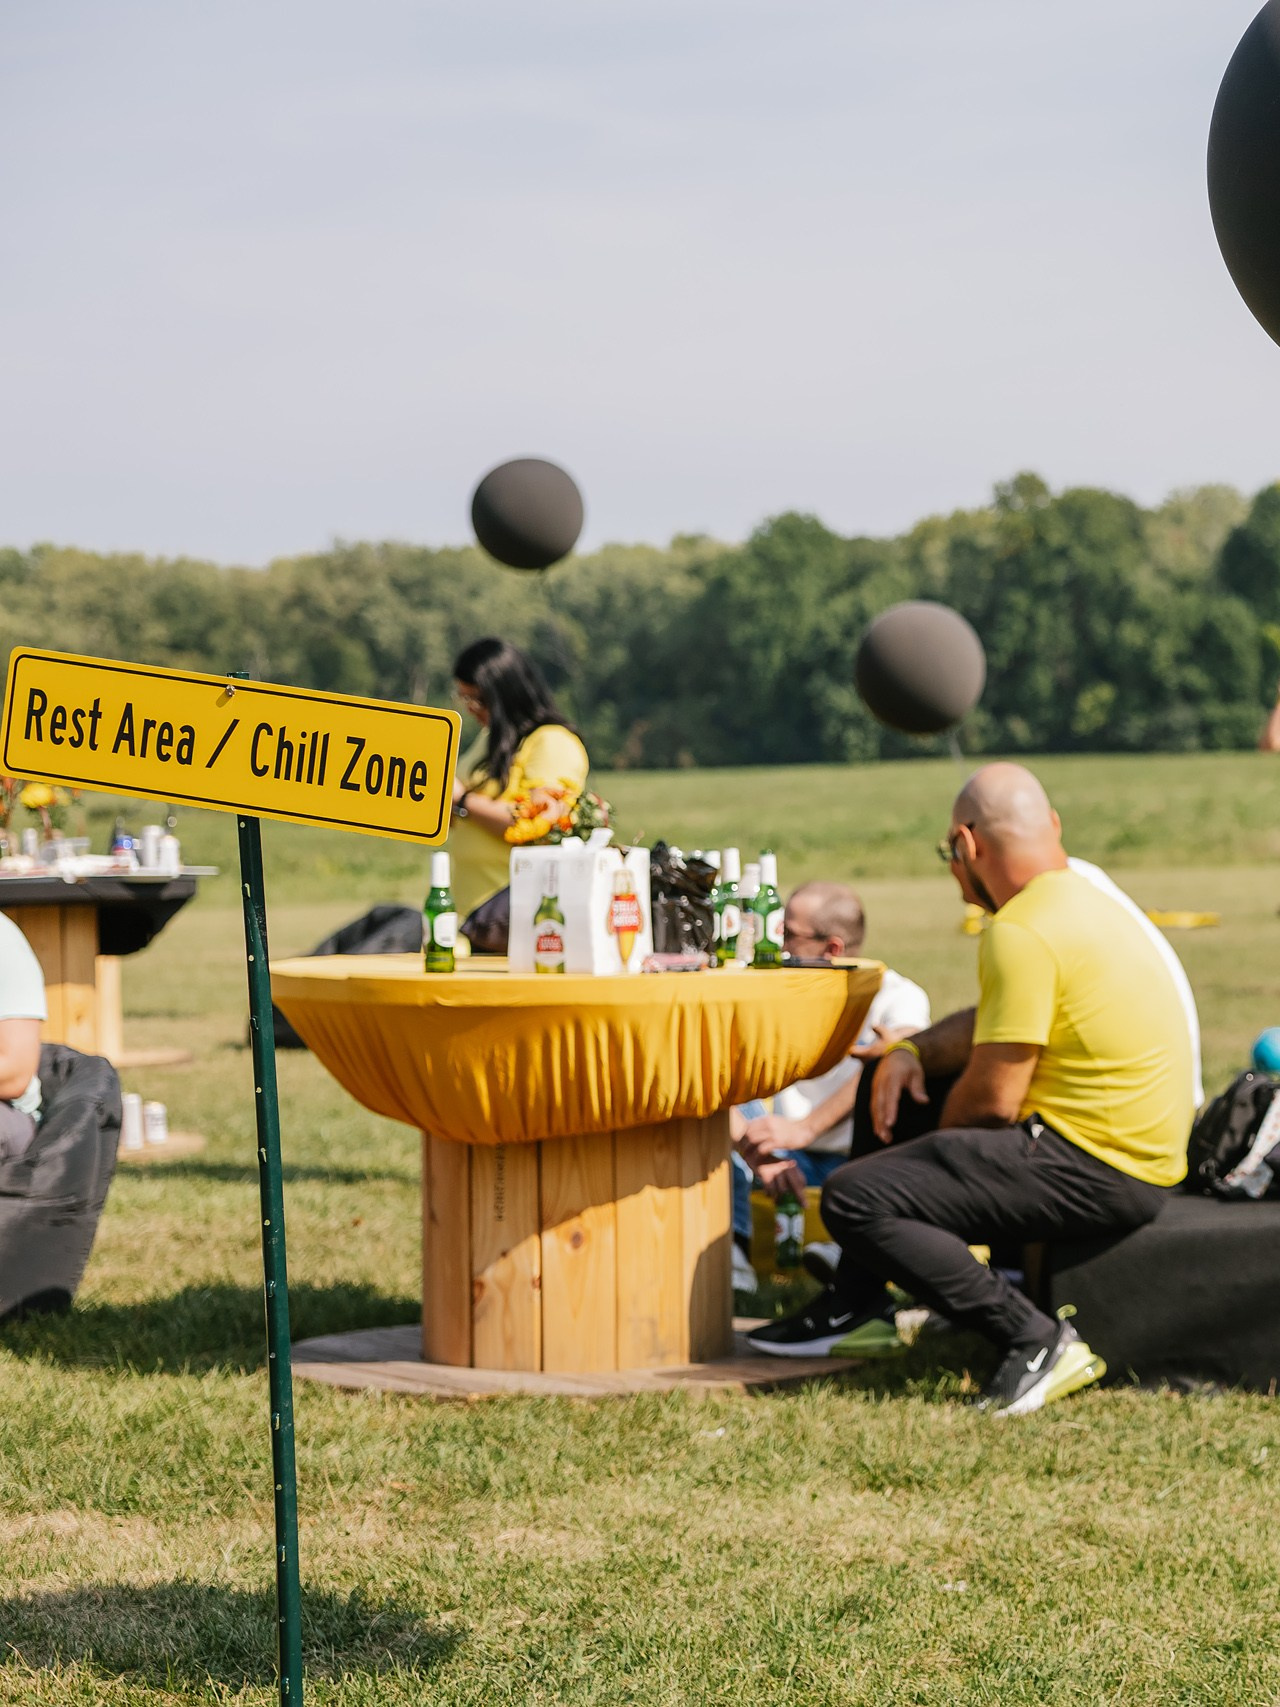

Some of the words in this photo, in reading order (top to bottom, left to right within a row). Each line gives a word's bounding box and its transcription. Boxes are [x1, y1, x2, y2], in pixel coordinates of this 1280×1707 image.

[25, 688, 102, 751] Rest
[112, 703, 195, 765] Area
[206, 719, 239, 768] /
[251, 723, 329, 786] Chill
[340, 736, 427, 801] Zone
